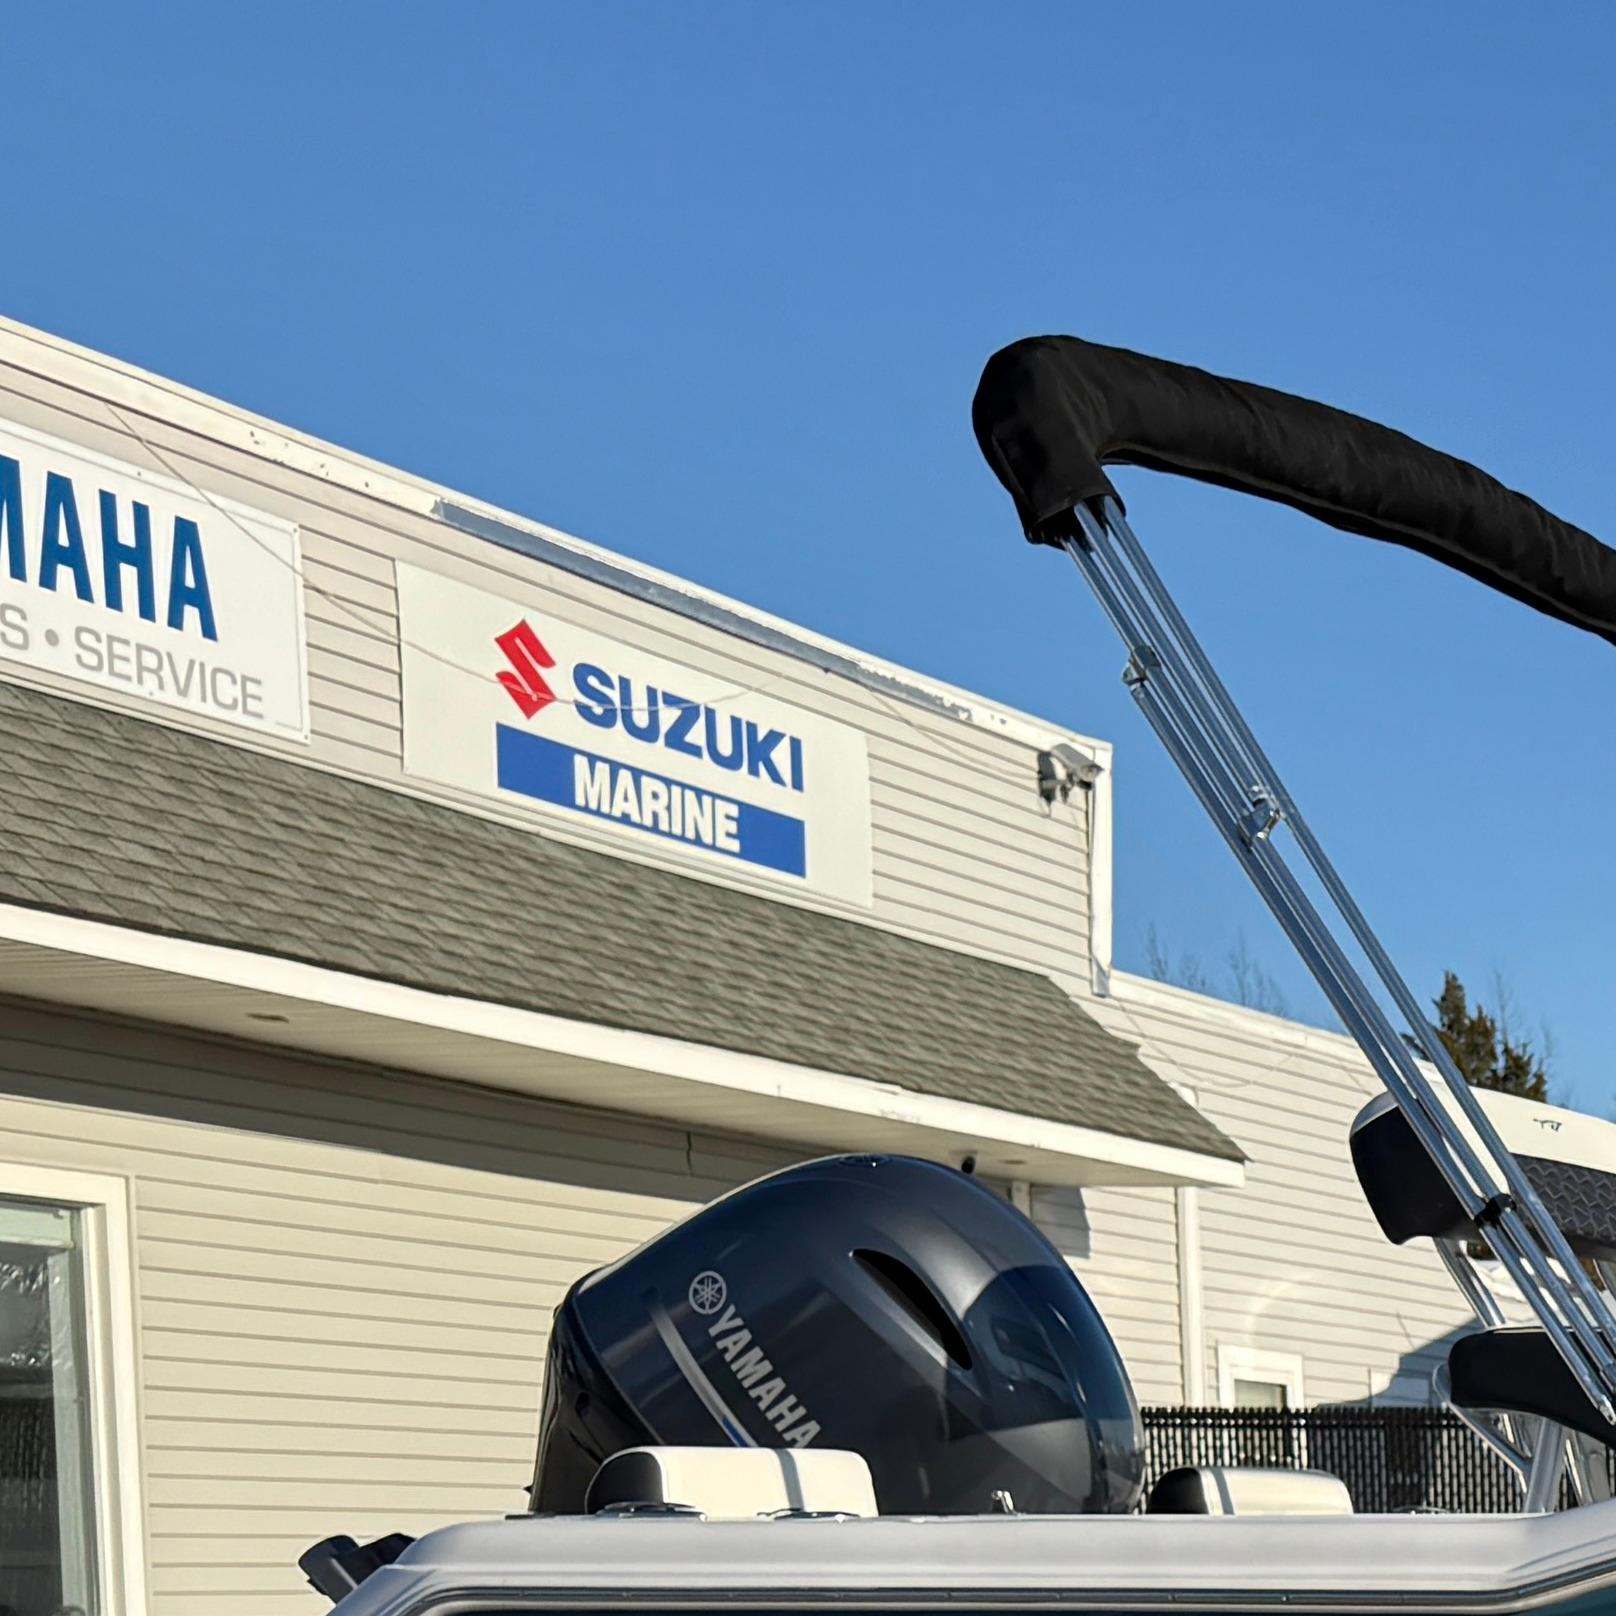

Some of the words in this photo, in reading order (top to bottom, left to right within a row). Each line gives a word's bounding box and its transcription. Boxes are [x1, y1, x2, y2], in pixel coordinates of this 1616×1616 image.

[74, 625, 264, 719] SERVICE
[573, 662, 804, 793] SUZUKI
[573, 753, 740, 853] MARINE
[708, 1304, 822, 1448] YAMAHA
